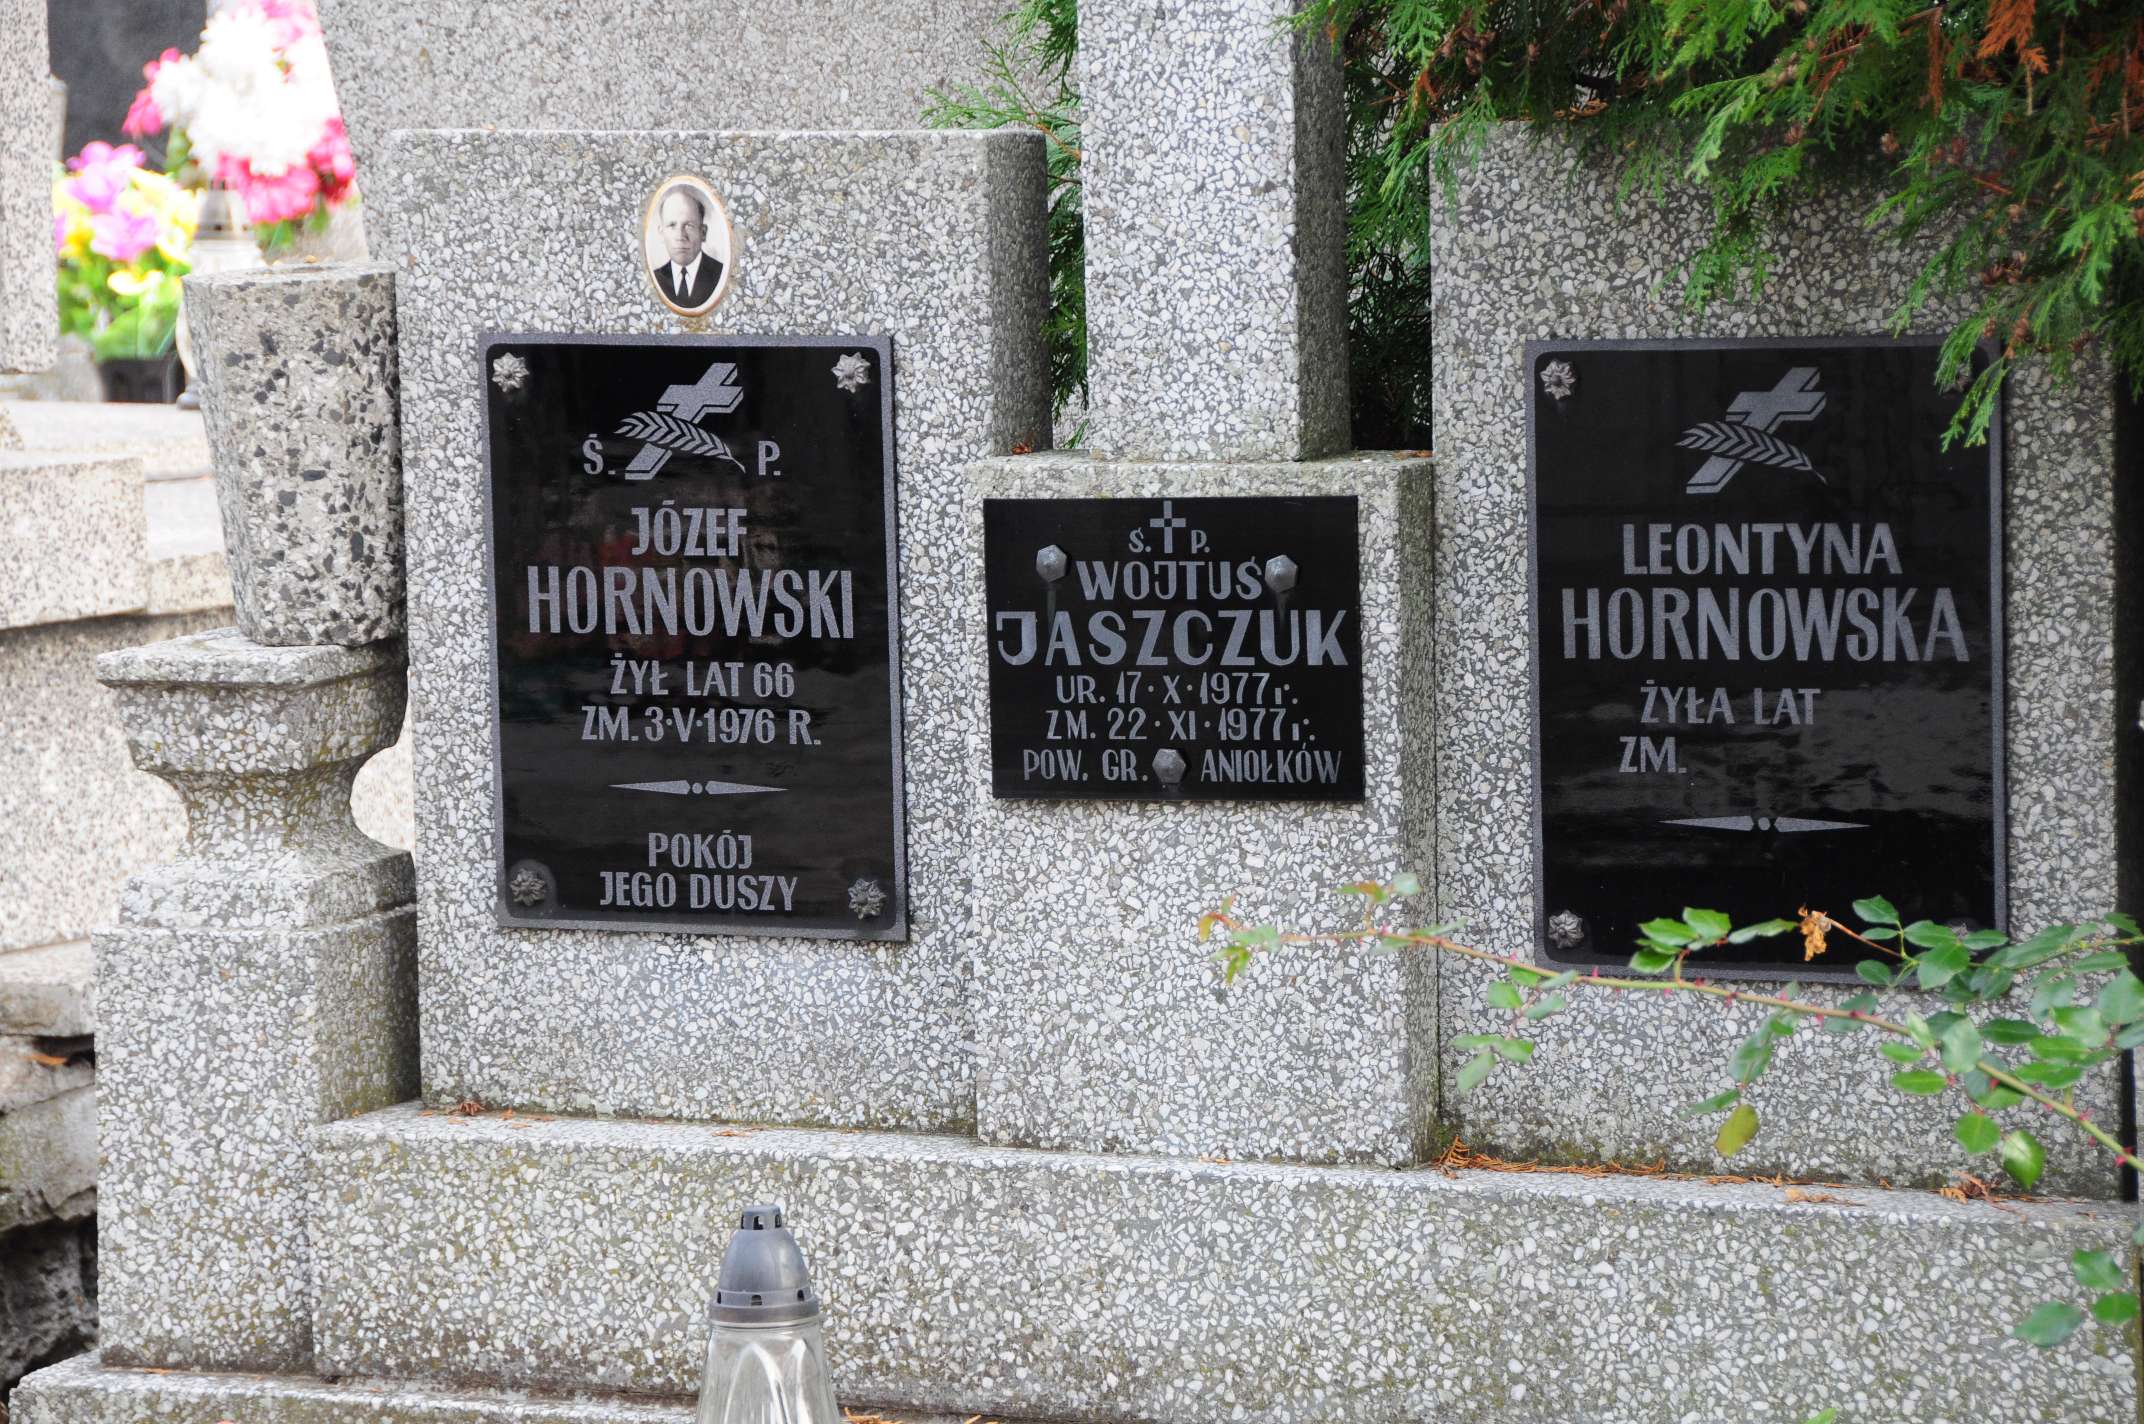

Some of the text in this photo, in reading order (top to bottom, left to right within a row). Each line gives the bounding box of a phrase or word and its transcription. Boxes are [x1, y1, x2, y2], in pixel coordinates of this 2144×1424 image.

[759, 441, 780, 475] P.
[632, 500, 747, 557] JÓZEF
[1623, 523, 1902, 574] LEONTYNA
[1076, 556, 1262, 601] WOJTUŚ
[528, 566, 853, 638] HORNOWSKI
[996, 610, 1348, 666] JASZCZUK
[1562, 588, 1969, 661] HORNOWSKA
[611, 653, 794, 697] ŻYŁ LAT 66
[1057, 676, 1105, 703] UR.
[1046, 710, 1096, 739] ZM.
[1641, 680, 1820, 725] ŻYŁA LAT
[582, 706, 638, 741] ZM.
[789, 710, 821, 745] R.
[1024, 738, 1341, 783] POW. GR. ANIOŁKÓW
[1619, 736, 1687, 773] ZM.
[649, 830, 752, 869] POKÓJ
[600, 872, 797, 910] JEGO DUSZY
